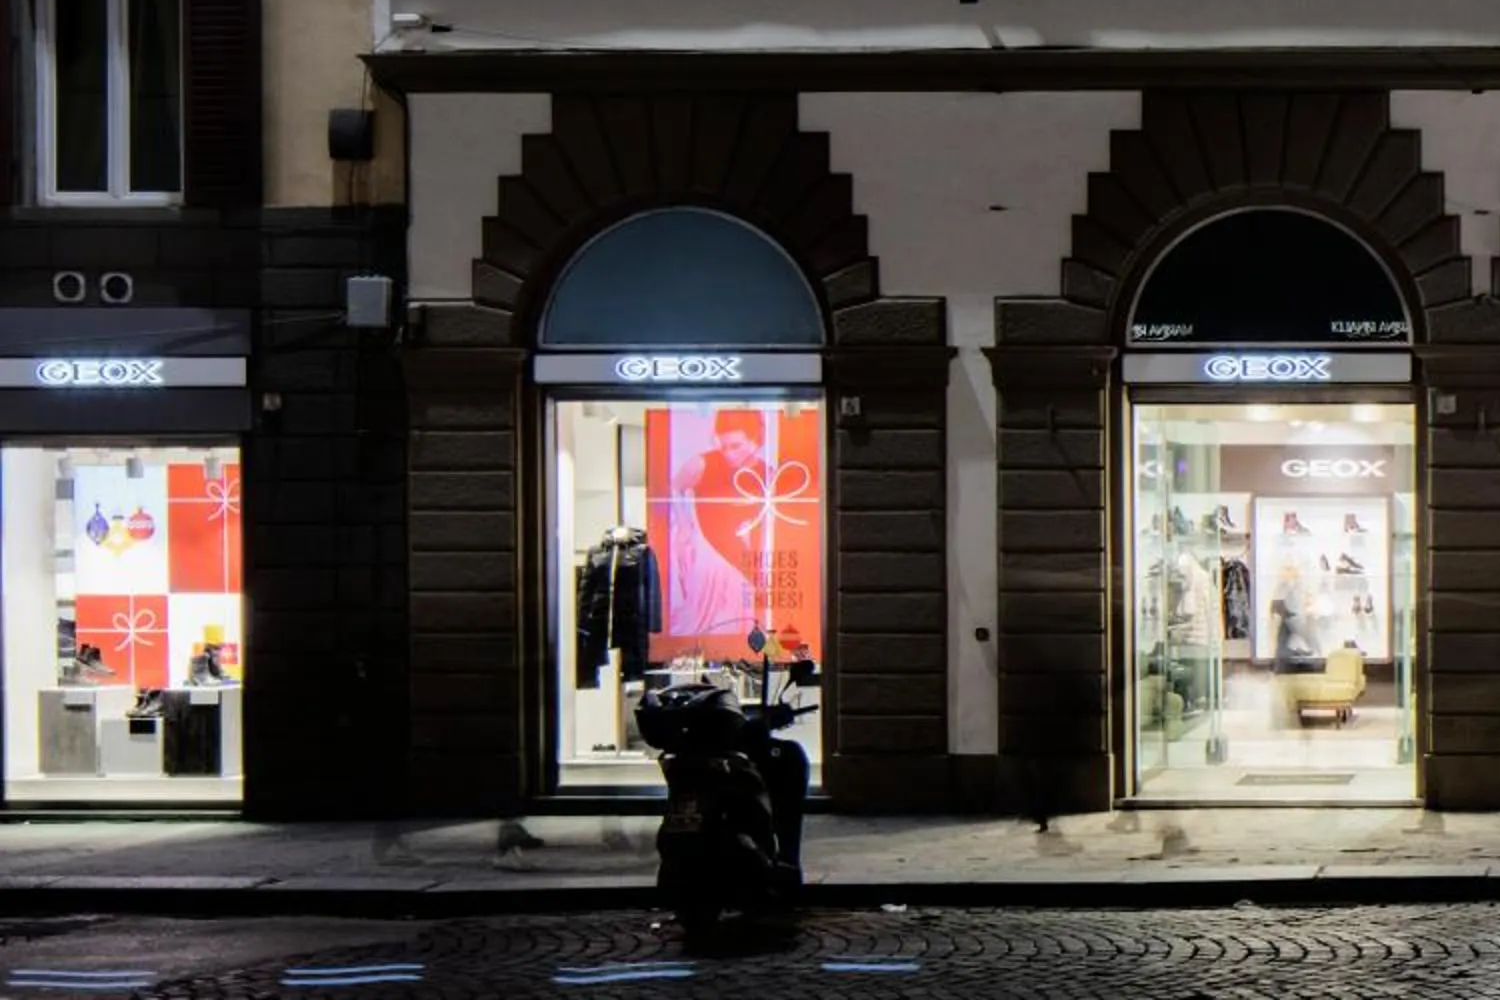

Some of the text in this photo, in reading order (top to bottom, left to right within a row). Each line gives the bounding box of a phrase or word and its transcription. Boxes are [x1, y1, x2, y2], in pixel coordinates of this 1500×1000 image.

[37, 359, 165, 385] GEOX
[615, 355, 744, 382] GEOX
[1204, 354, 1333, 382] GEOX
[1280, 460, 1387, 478] GEOX
[741, 549, 798, 569] SHOES
